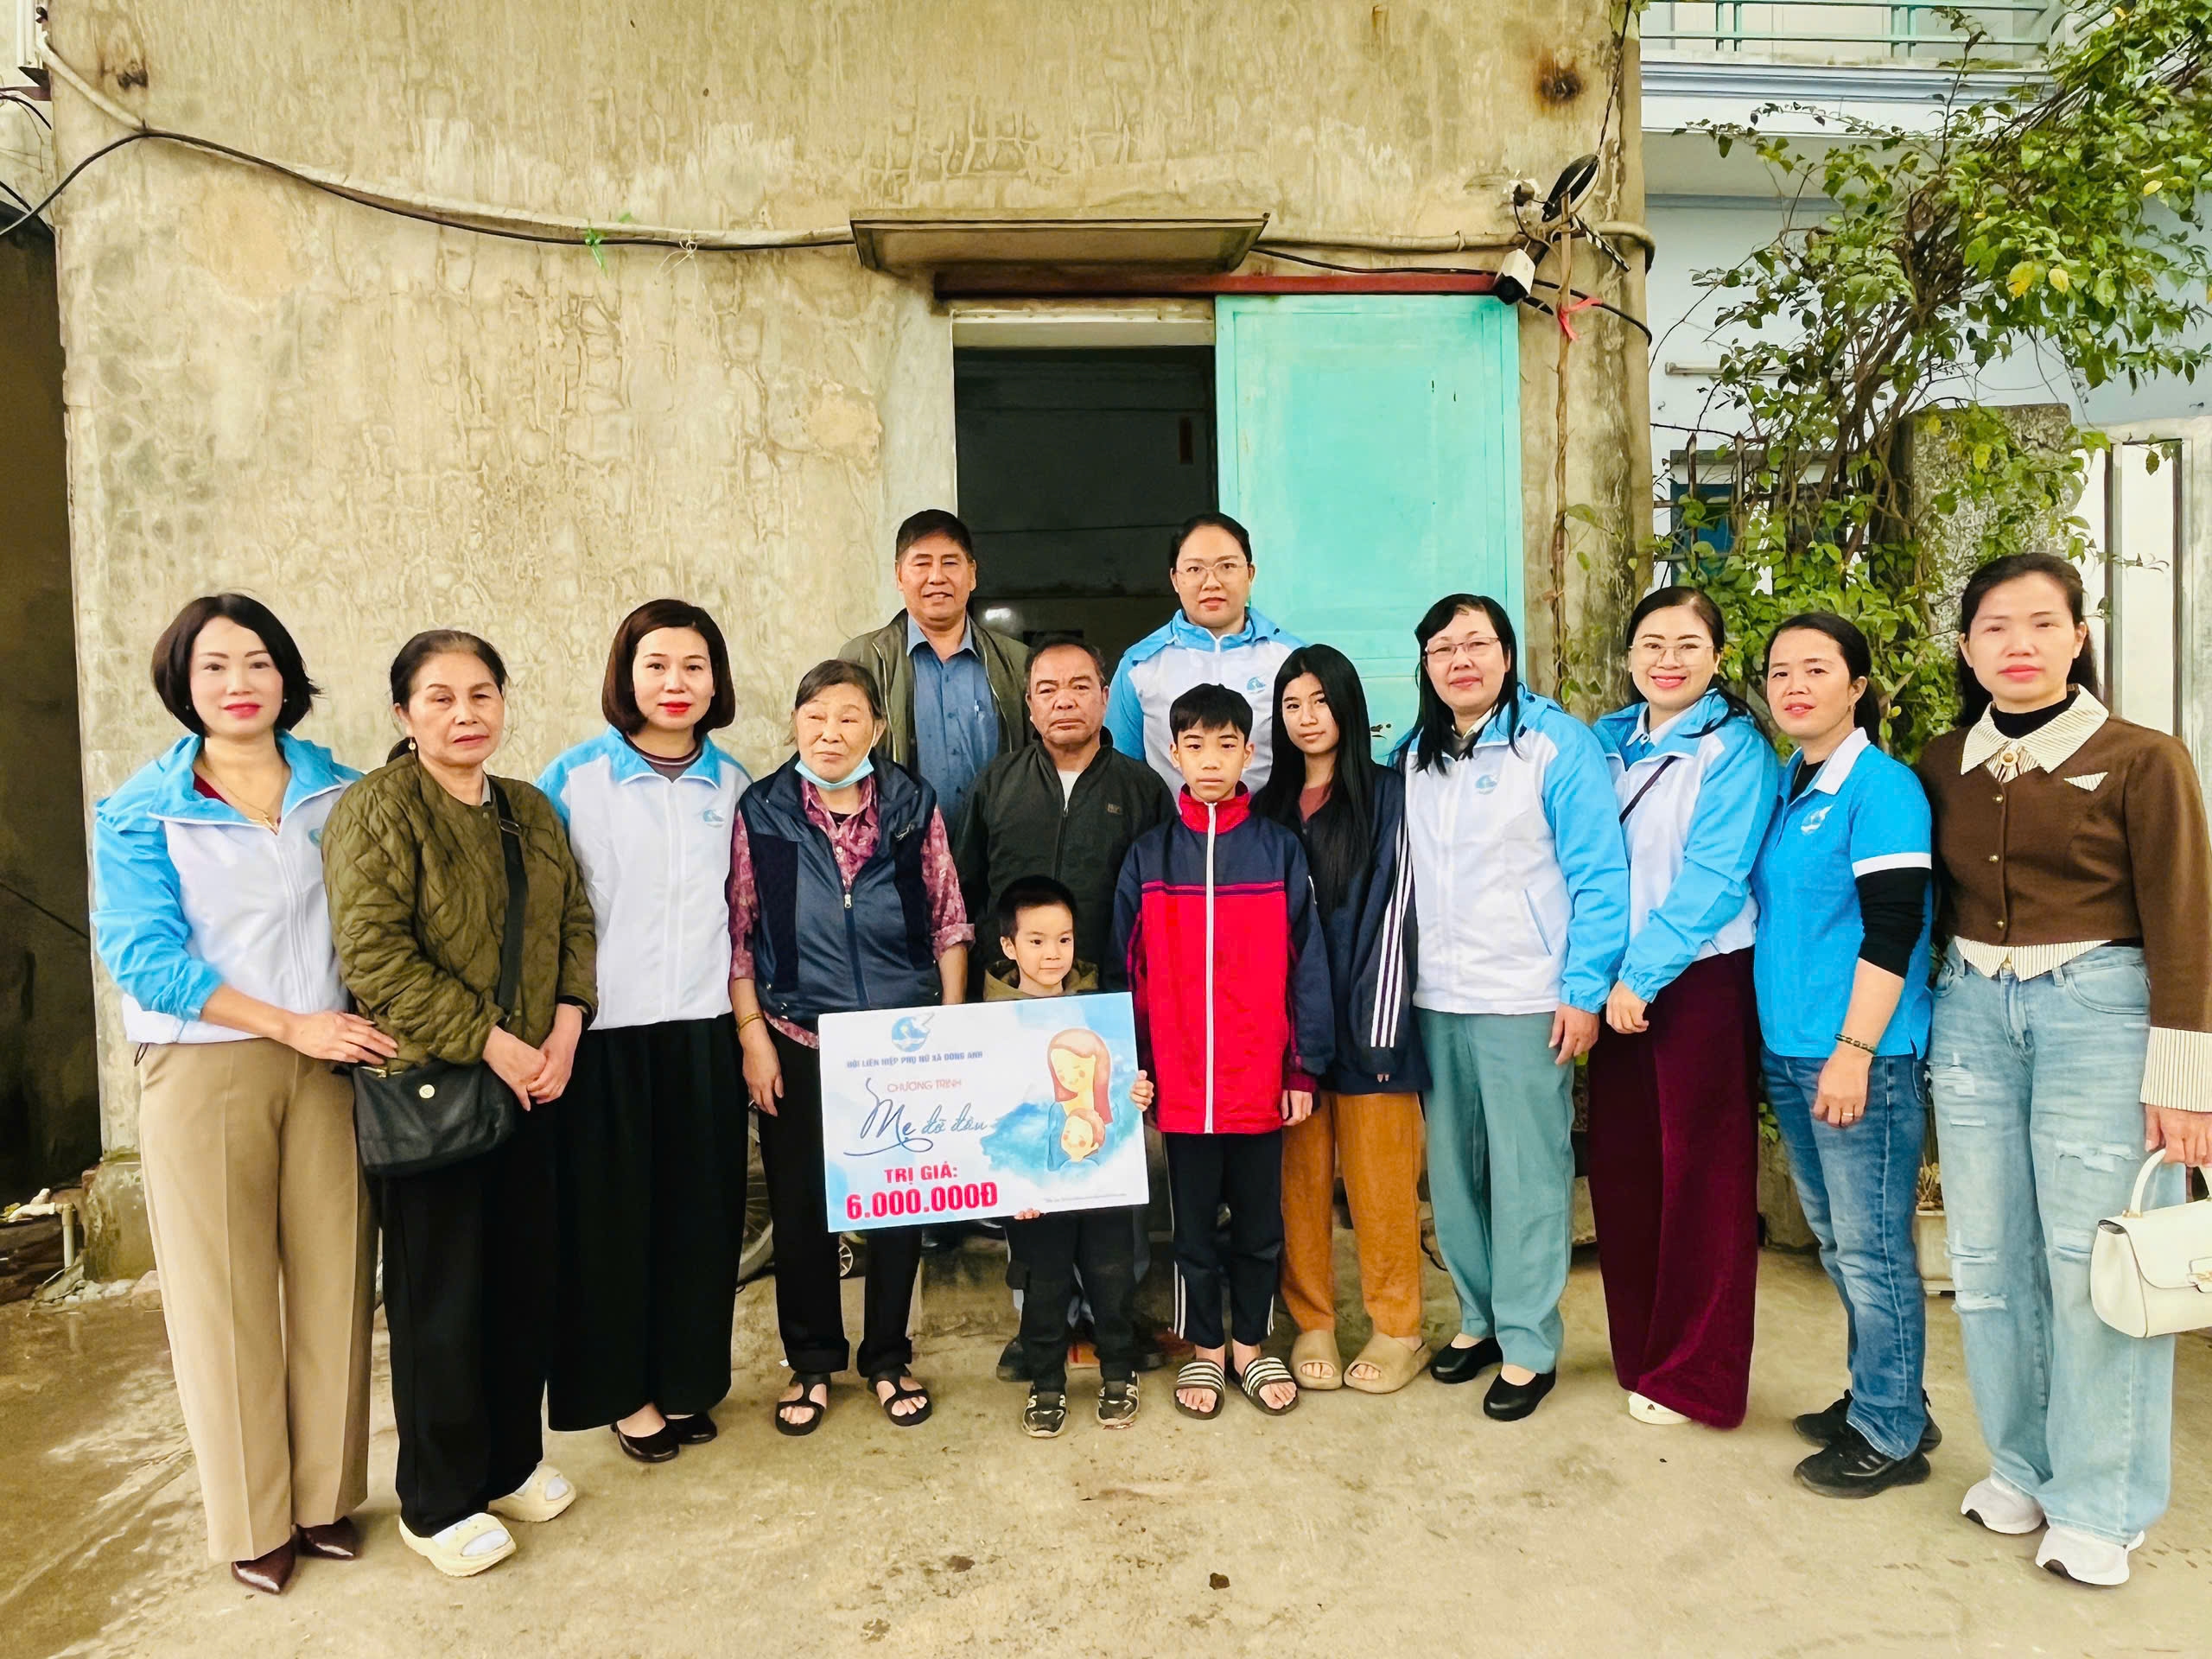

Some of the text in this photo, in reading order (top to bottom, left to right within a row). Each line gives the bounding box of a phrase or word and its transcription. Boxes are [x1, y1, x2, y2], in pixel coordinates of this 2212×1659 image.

[967, 1051, 983, 1059] ANH
[887, 1080, 933, 1093] CHƯƠNG
[884, 1161, 957, 1185] TRỊ GIÁ:
[846, 1181, 998, 1221] 6.000.000Đ
